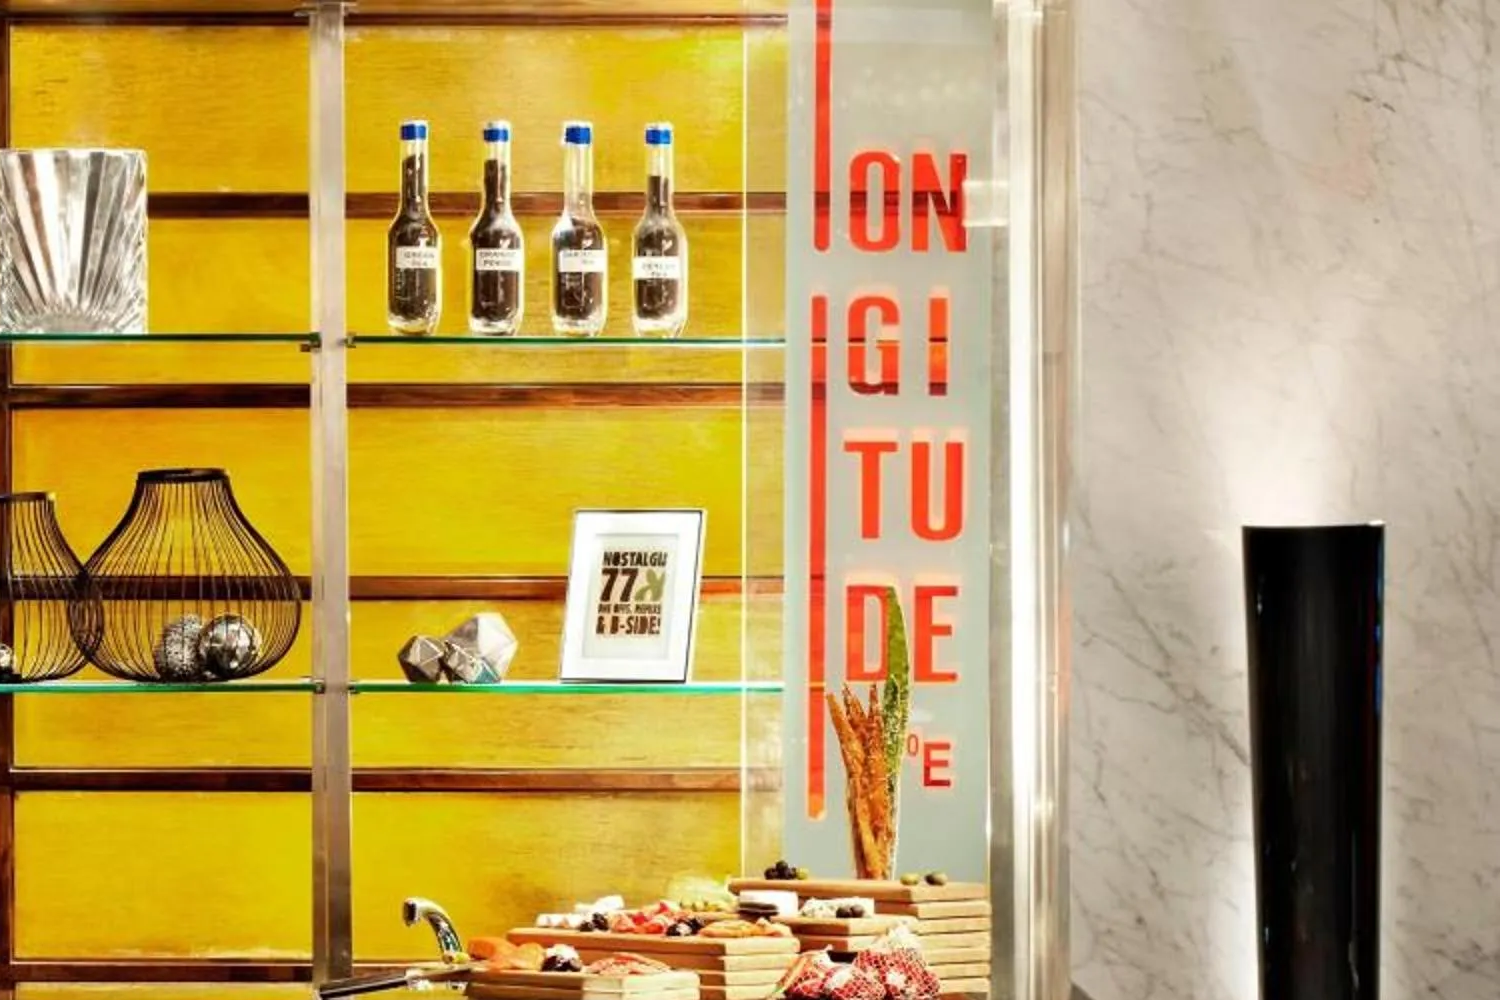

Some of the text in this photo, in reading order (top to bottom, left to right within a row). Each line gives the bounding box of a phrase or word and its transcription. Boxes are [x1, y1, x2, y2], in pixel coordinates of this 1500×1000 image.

[843, 441, 964, 541] TU
[600, 567, 638, 602] 77
[845, 585, 958, 683] DE
